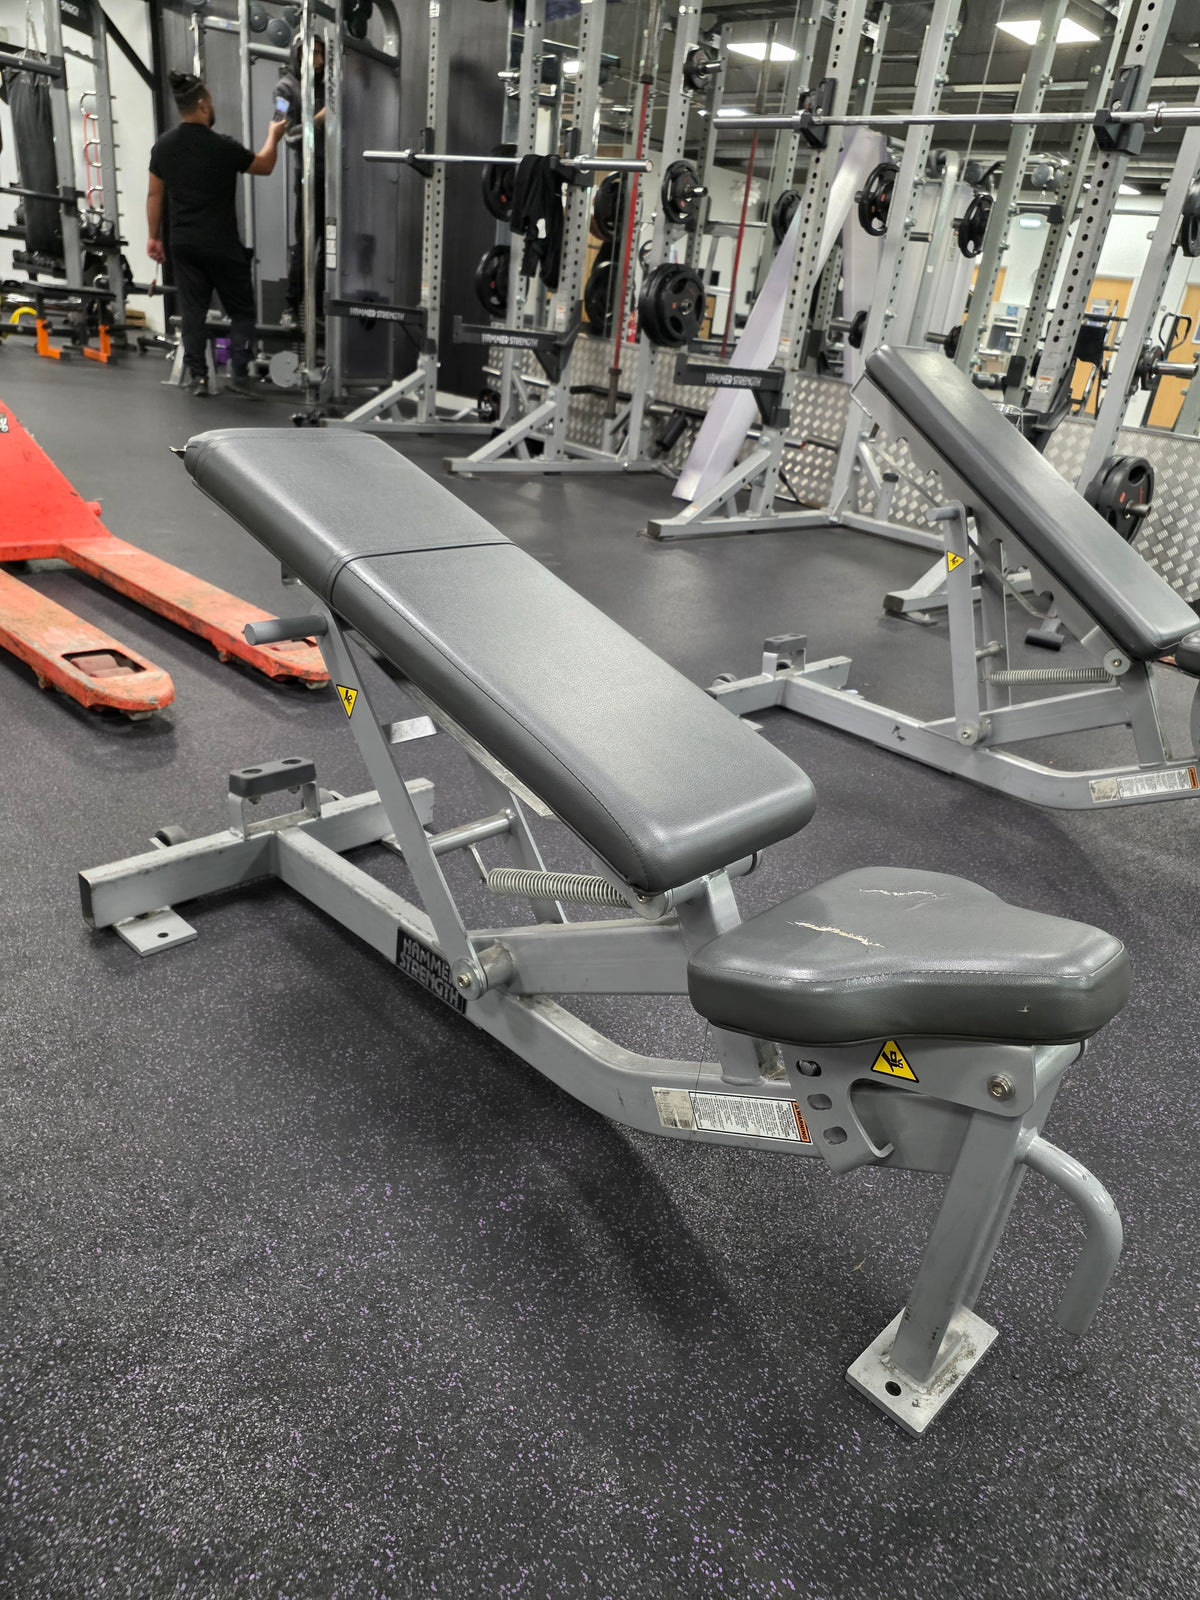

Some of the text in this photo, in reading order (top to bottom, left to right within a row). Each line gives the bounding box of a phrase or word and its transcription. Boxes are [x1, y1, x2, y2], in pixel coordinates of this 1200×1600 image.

[349, 307, 405, 321] HAMMER STRENGTH
[481, 333, 539, 347] HAMMER STRENGTH
[705, 372, 762, 387] HAMMER STRENGTH
[403, 937, 453, 984] HAMME
[399, 951, 459, 1008] STRENGTH
[797, 1110, 809, 1140] WARNING
